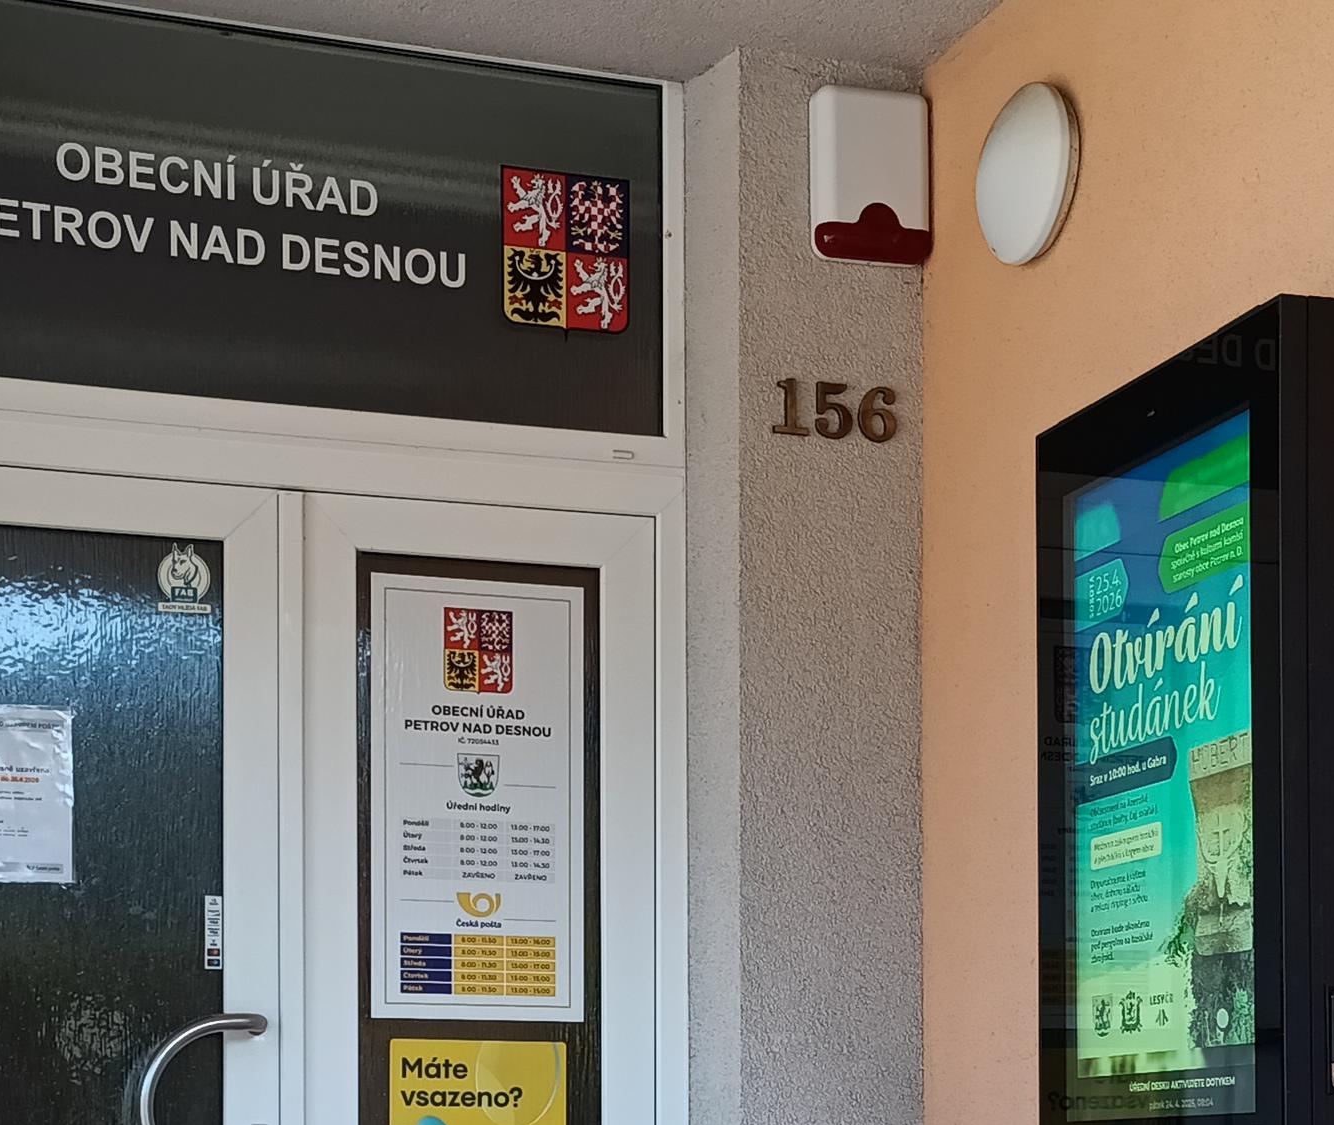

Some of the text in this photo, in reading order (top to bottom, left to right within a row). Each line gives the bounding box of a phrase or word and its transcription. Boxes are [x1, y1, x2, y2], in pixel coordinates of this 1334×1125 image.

[56, 142, 378, 216] OBECNÍ ÚŘAD
[170, 220, 266, 265] NAD
[282, 233, 466, 288] DESNOU
[772, 378, 898, 443] 156
[174, 588, 194, 597] FAB
[1096, 569, 1122, 595] 25.4.
[1096, 588, 1122, 616] 2026
[1089, 574, 1243, 695] Otvírání
[431, 704, 525, 720] OBECNÍ ÚŘAD
[1089, 661, 1222, 765] studánek
[404, 719, 551, 738] PETROV NAD DESNOU
[446, 800, 511, 815] Úřední hodiny
[456, 918, 502, 929] Česká pošta
[400, 1056, 469, 1080] Máte
[400, 1086, 524, 1109] vsazeno?
